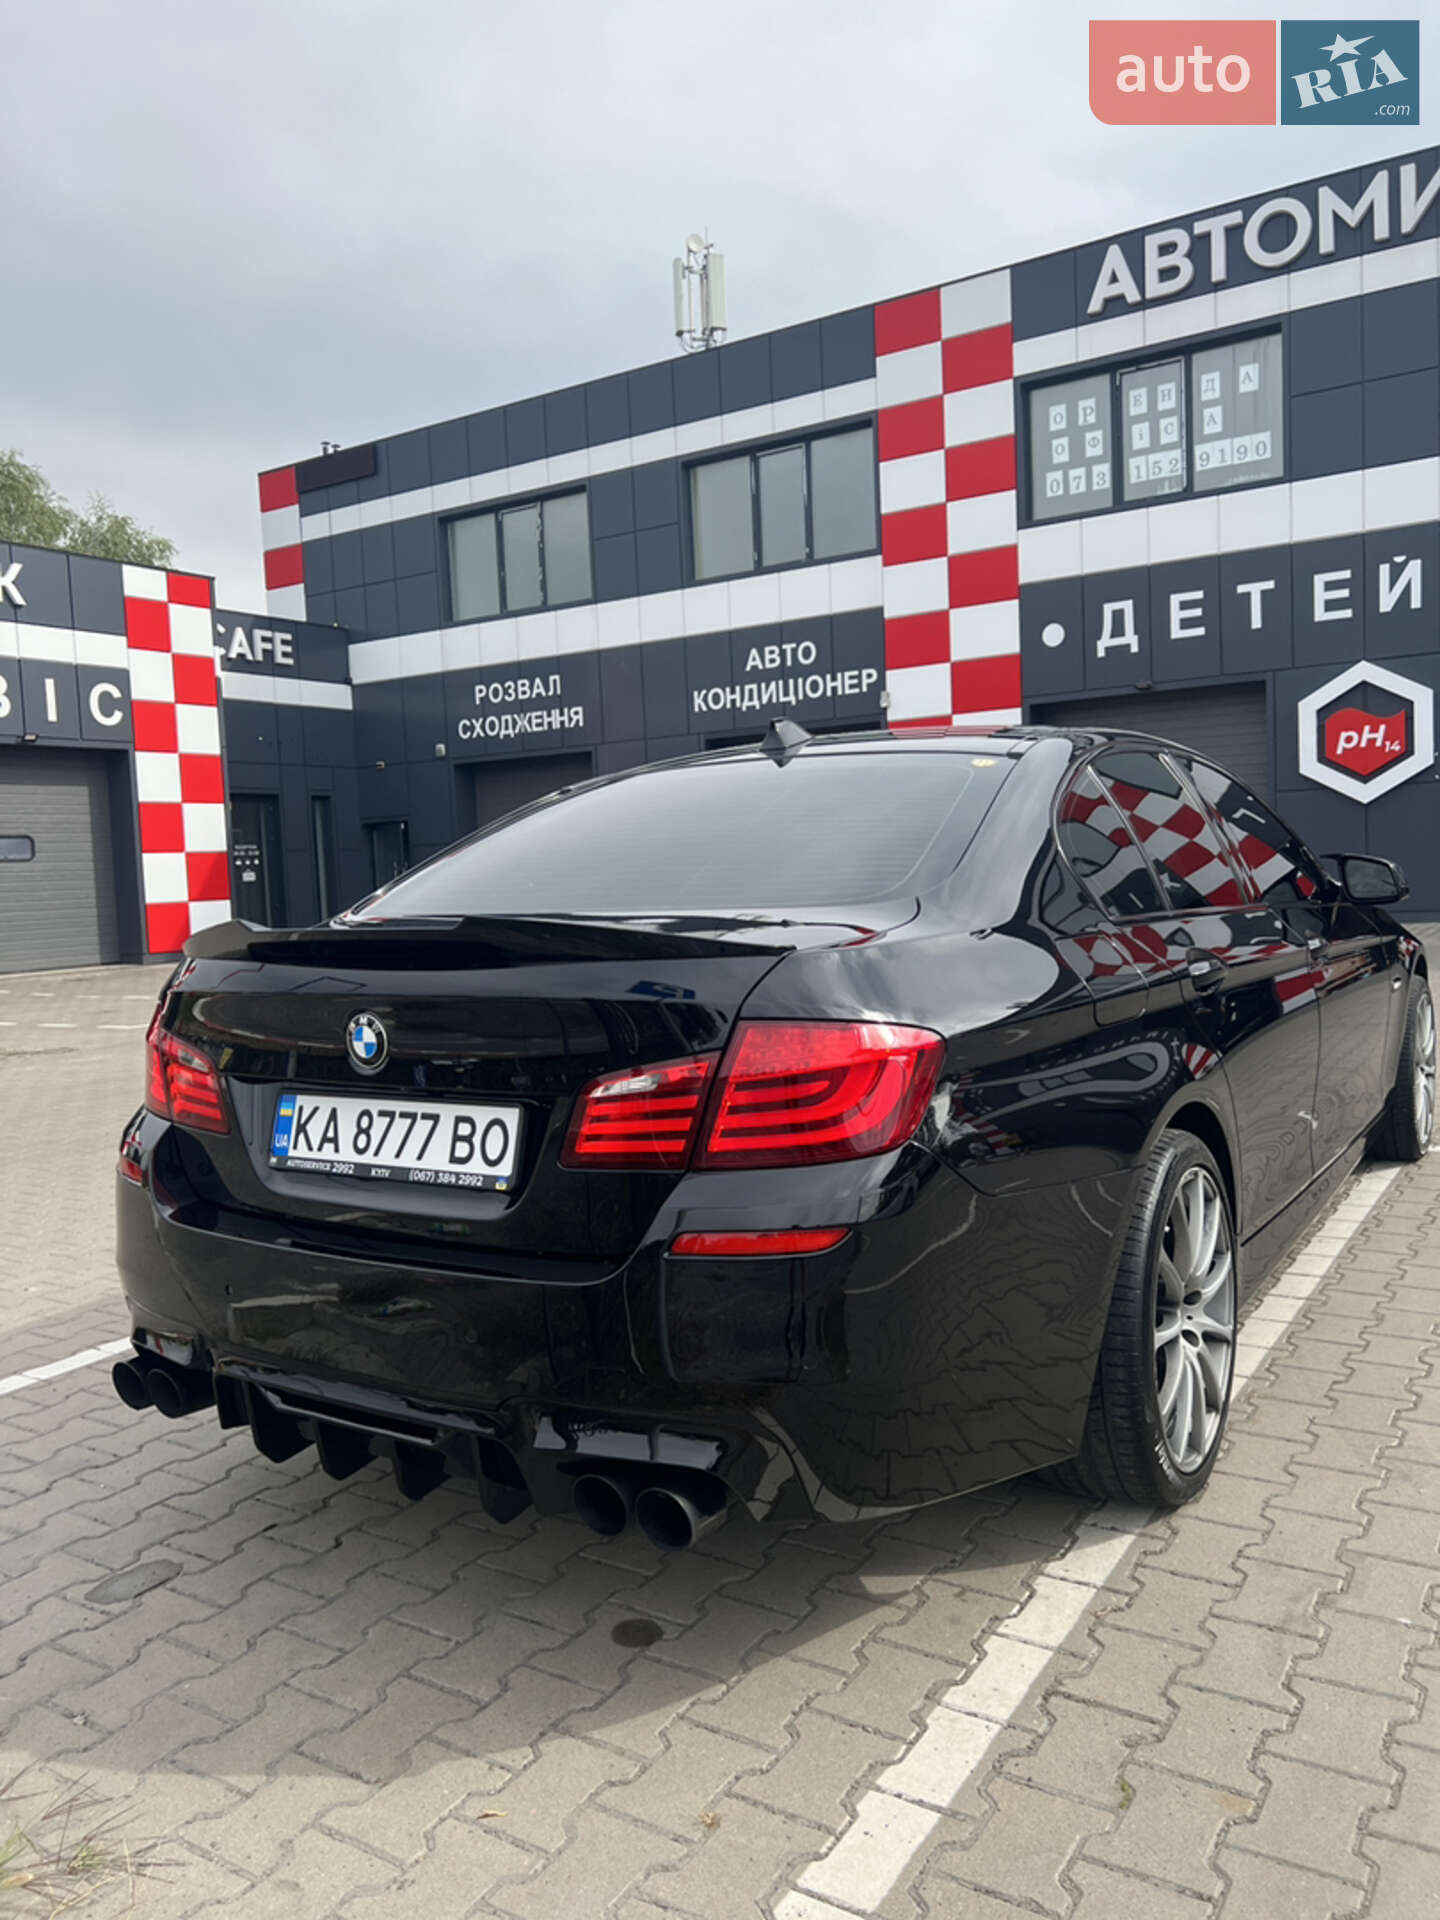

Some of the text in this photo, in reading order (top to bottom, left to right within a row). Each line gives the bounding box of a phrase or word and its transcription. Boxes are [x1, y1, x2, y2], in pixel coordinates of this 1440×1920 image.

[1096, 555, 1422, 658] ДЕТЕЙ
[746, 640, 817, 671] АВТО
[474, 674, 562, 705] РОЗВАЛ
[693, 668, 878, 713] КОНДИЦІОНЕР
[457, 706, 584, 741] СХОДЖЕННЯ
[274, 1133, 289, 1148] UA
[292, 1105, 510, 1168] KA 8777 BO
